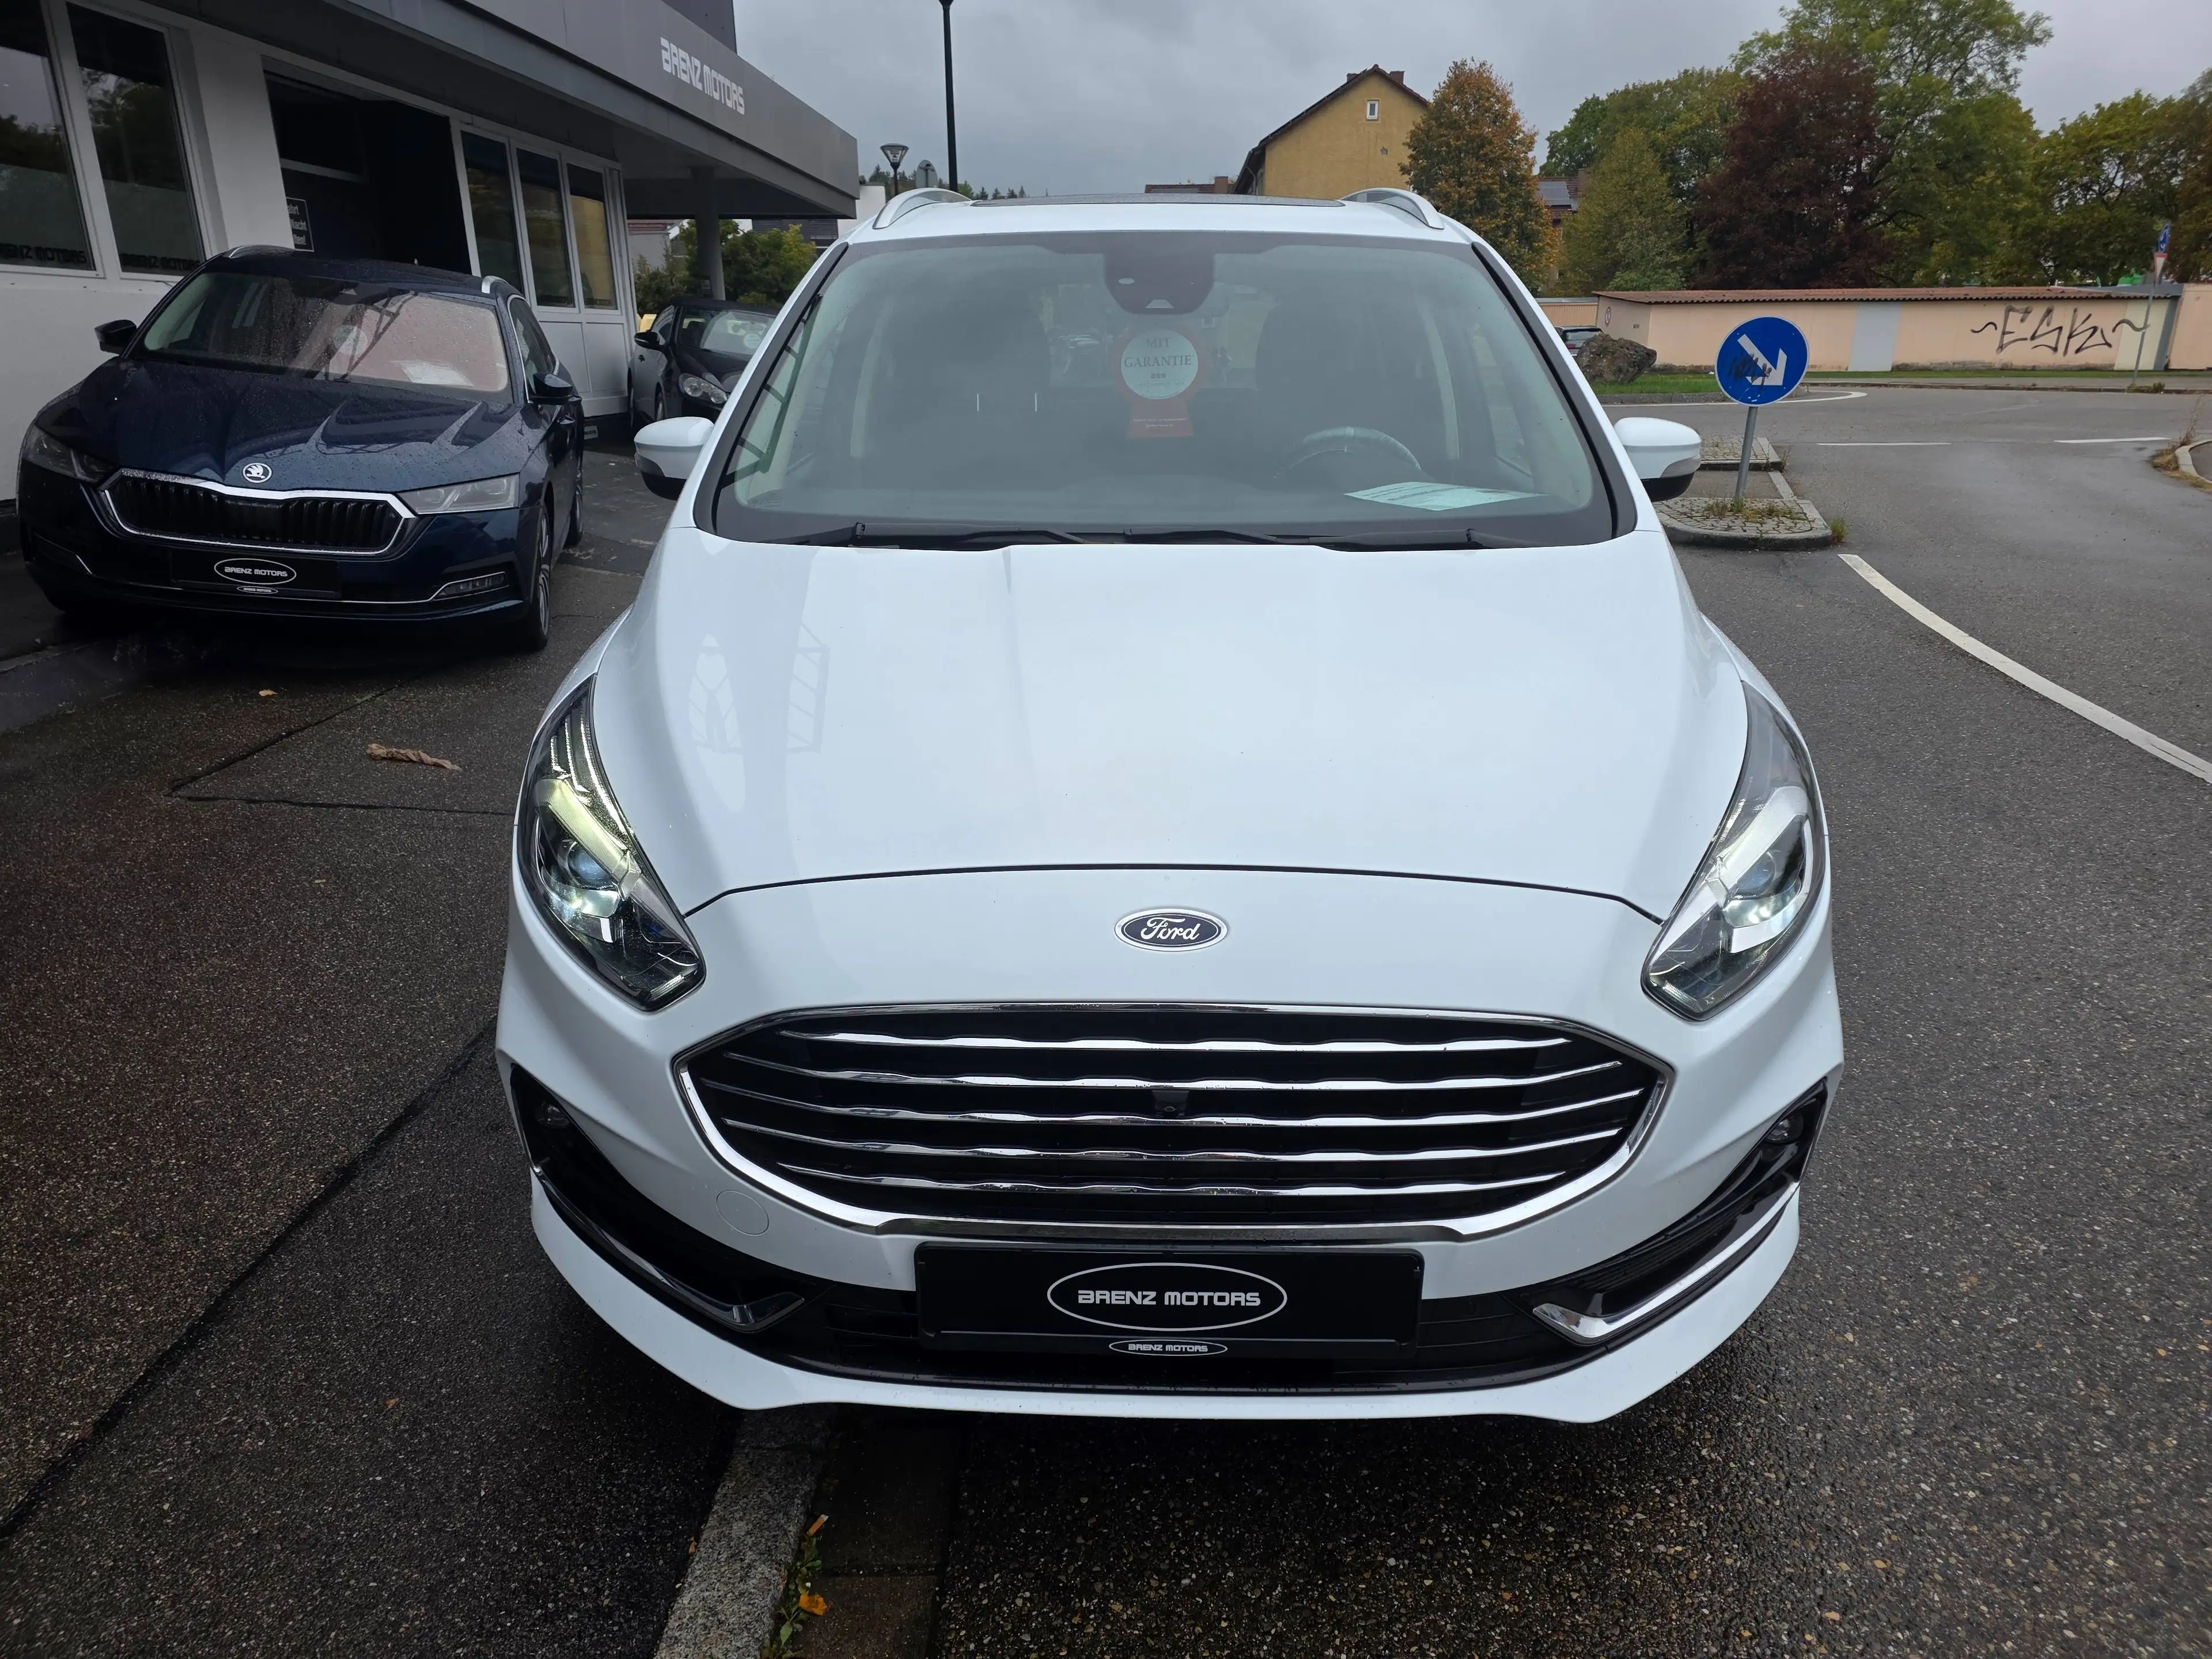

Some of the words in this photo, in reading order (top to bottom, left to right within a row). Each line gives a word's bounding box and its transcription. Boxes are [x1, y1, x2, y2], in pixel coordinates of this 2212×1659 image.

[661, 36, 703, 91] BRENZ
[703, 65, 745, 115] MOTORS
[1146, 337, 1172, 349] MIT
[1124, 354, 1192, 368] GARANTIE
[1141, 917, 1201, 940] Ford
[1078, 1290, 1156, 1305] BRENZ
[1164, 1291, 1261, 1306] MOTORS
[1165, 1344, 1208, 1352] MOTORS
